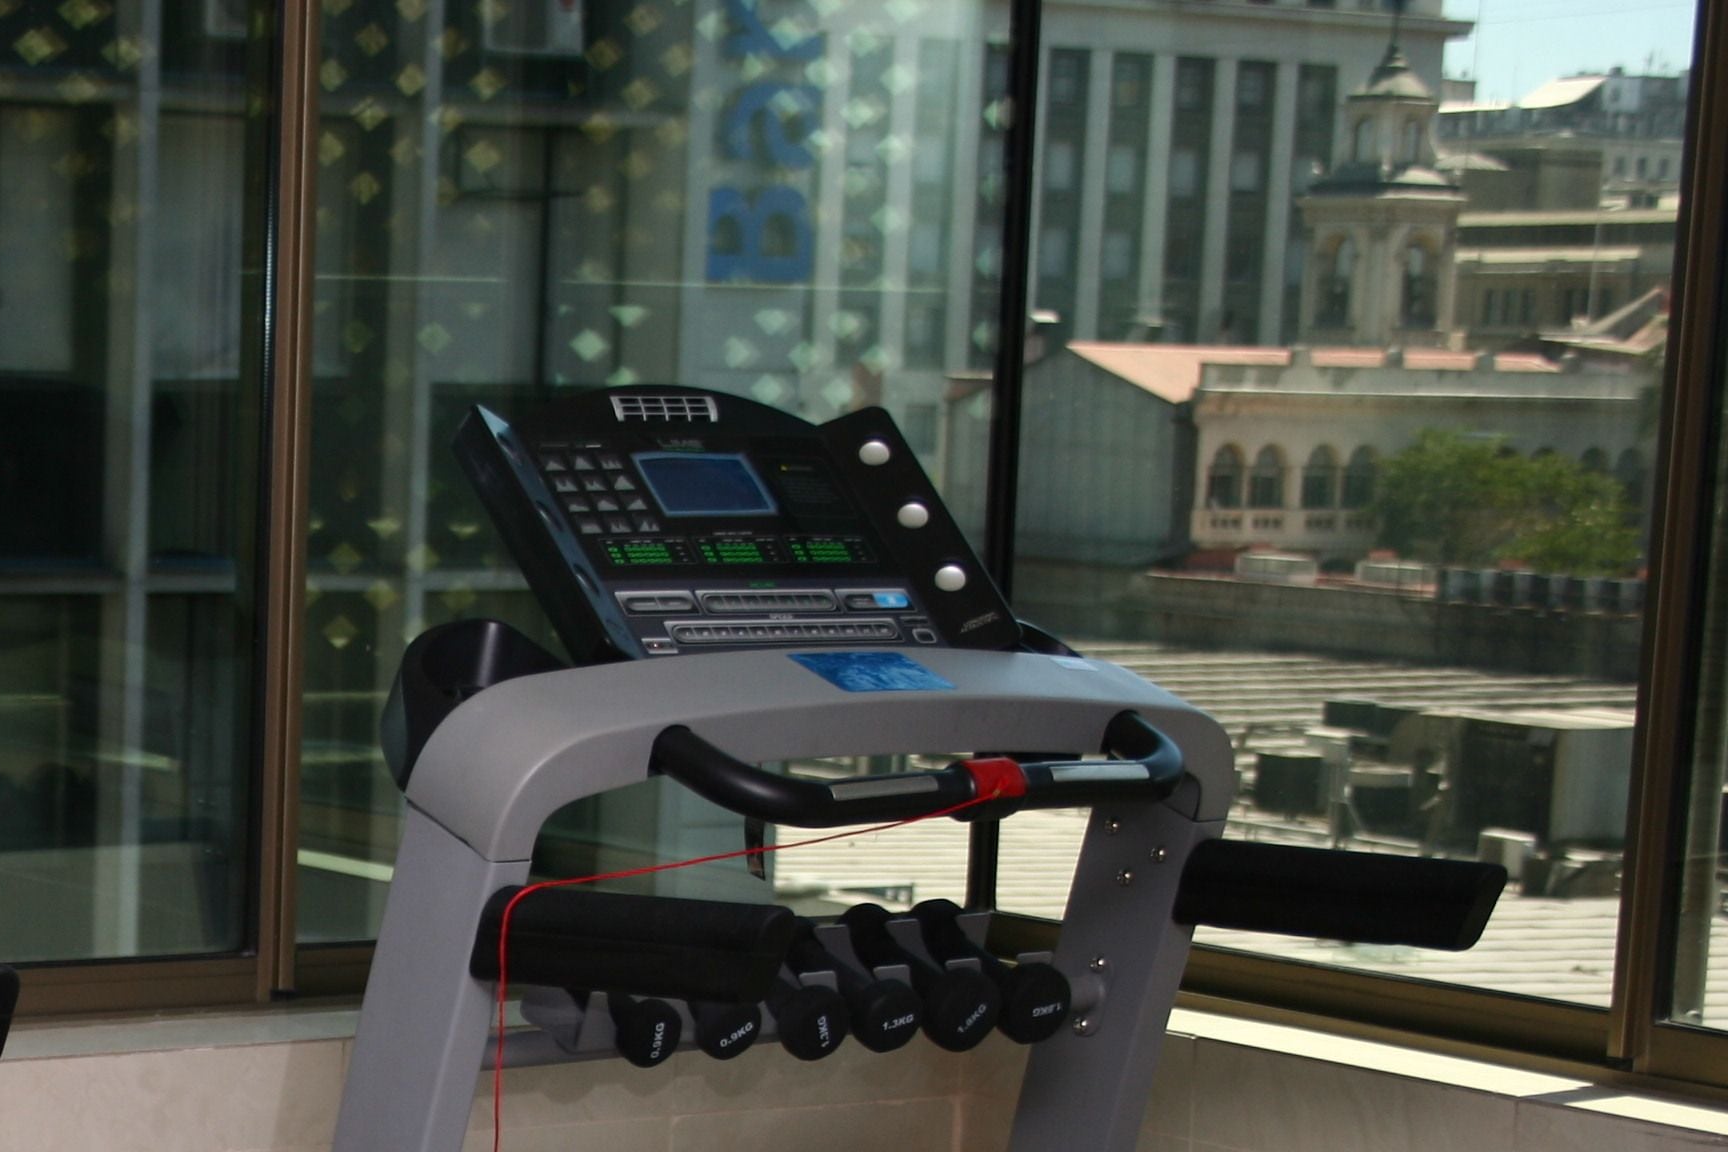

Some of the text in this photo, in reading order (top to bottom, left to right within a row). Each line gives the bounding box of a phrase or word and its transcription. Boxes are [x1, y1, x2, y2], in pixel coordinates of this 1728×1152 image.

[719, 1021, 754, 1048] 0.9KG
[882, 1013, 915, 1031] 1.3KG
[650, 1021, 665, 1059] 0.9KG
